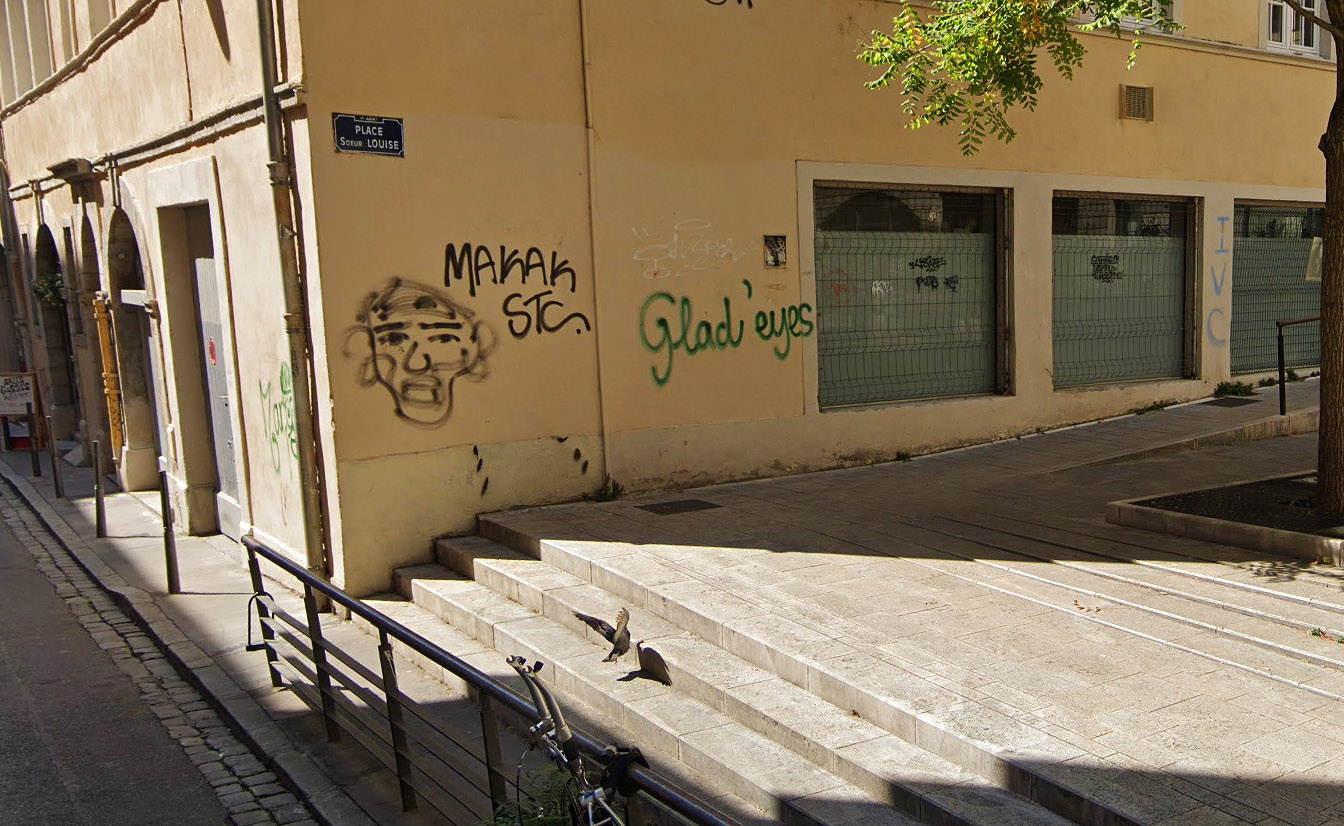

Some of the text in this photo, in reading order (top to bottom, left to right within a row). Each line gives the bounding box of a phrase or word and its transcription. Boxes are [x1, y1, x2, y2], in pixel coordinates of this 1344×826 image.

[355, 125, 383, 136] PLACE
[367, 138, 399, 149] LOUISE
[444, 242, 577, 297] MAKAK
